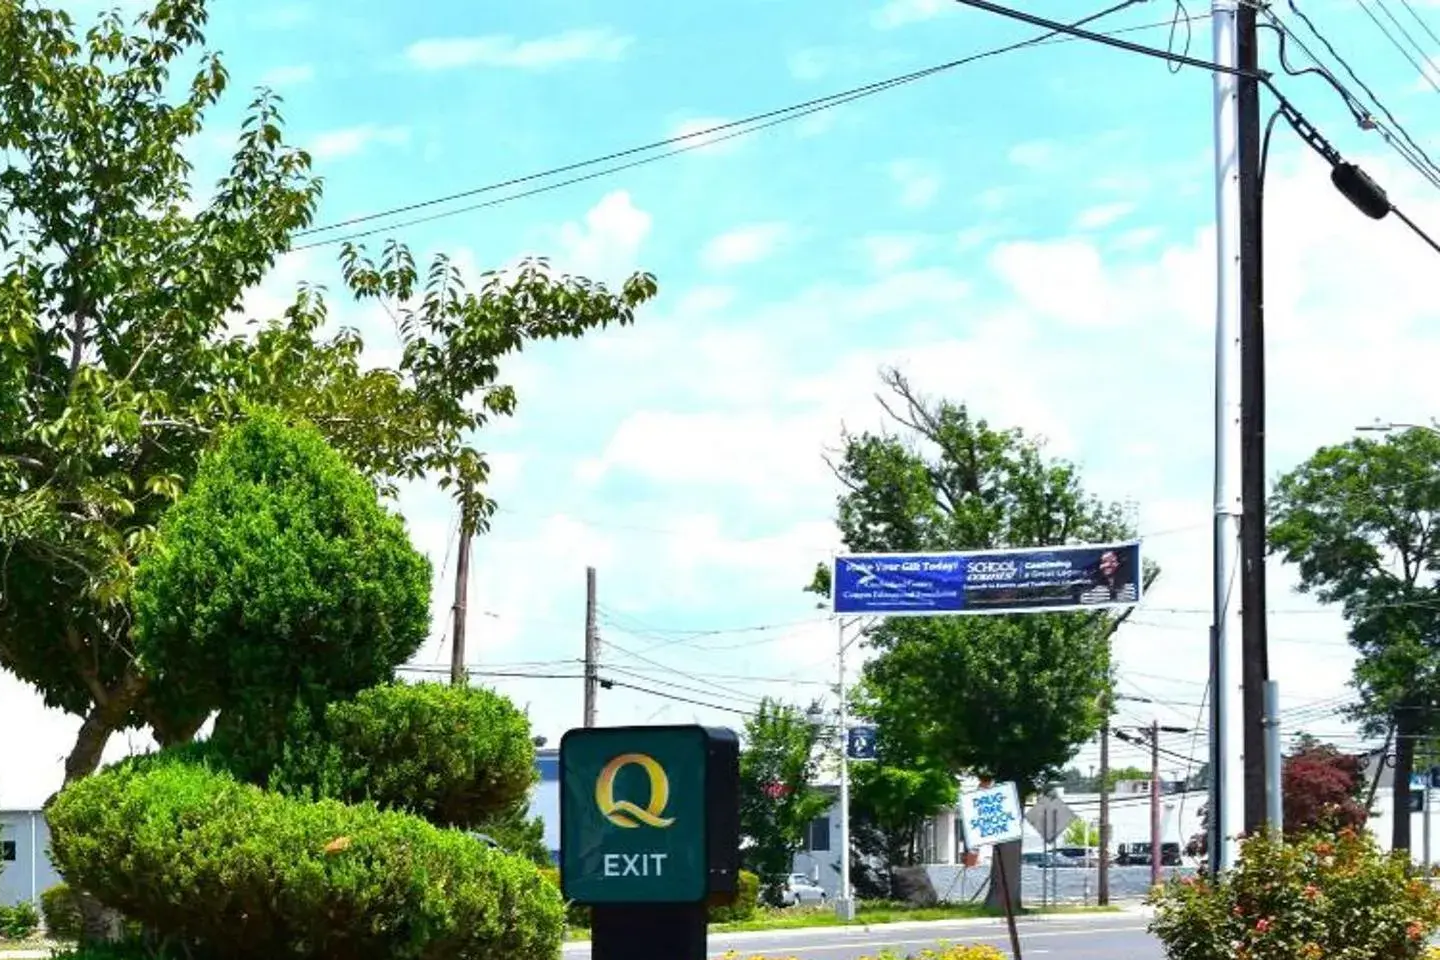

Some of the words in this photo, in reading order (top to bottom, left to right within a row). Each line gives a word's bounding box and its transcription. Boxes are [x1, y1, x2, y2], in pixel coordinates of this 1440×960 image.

[595, 753, 677, 829] Q
[970, 812, 1016, 829] SCHOOL
[980, 824, 1009, 837] ZONE
[603, 853, 668, 877] EXIT
